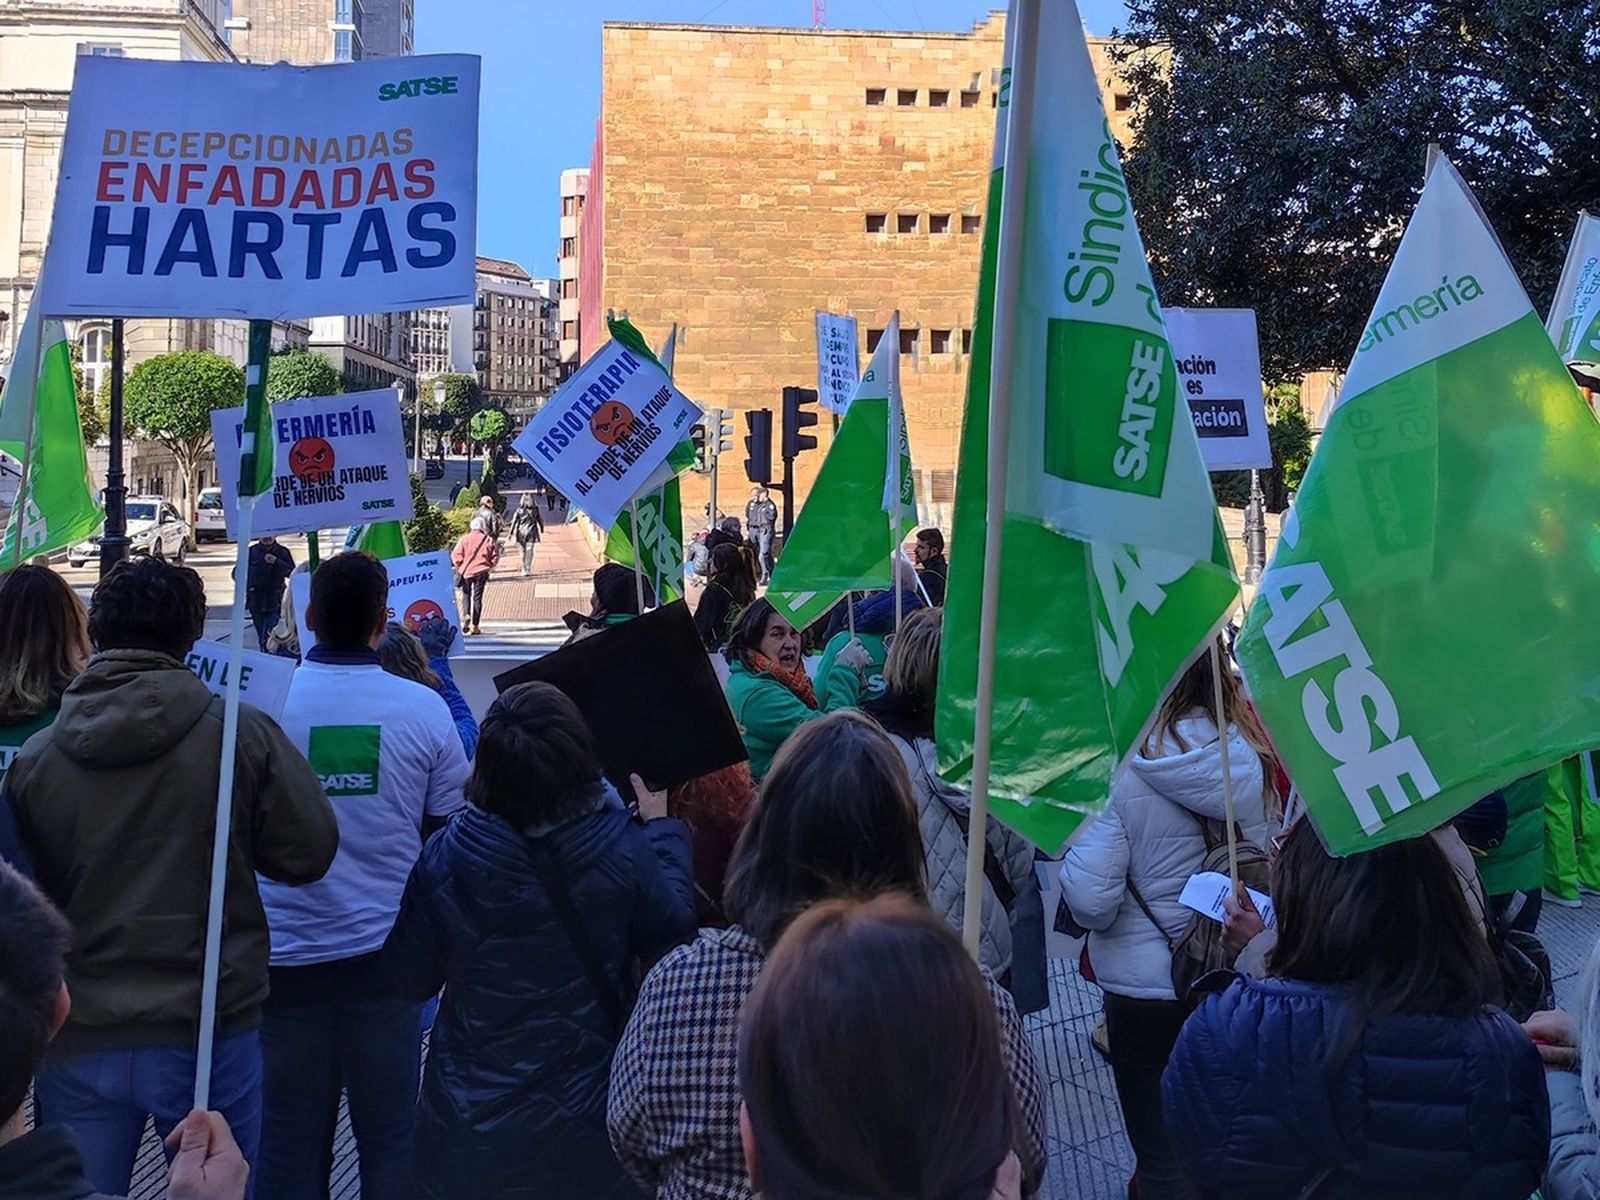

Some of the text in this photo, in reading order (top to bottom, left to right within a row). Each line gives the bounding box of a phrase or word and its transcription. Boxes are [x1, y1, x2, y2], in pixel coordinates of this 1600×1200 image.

[378, 76, 459, 102] SATSE
[102, 128, 414, 165] DECEPCIONADAS
[96, 158, 437, 211] ENFADADAS
[86, 200, 458, 281] HARTAS
[1186, 379, 1204, 396] es
[535, 350, 641, 463] FISIOTERAPIA
[672, 408, 689, 431] SATSE
[1112, 339, 1165, 482] SATSE
[1191, 406, 1242, 428] ación
[574, 384, 674, 497] AL BORDE DE UN ATAQUE
[607, 421, 663, 482] DE NERVIOS
[300, 473, 317, 489] DE
[318, 470, 336, 487] UN
[339, 464, 389, 486] ATAQUE
[274, 485, 346, 509] DE NERVIOS
[361, 499, 396, 511] SATSE
[388, 571, 434, 589] APEUTAS
[1262, 504, 1442, 838] ATSE
